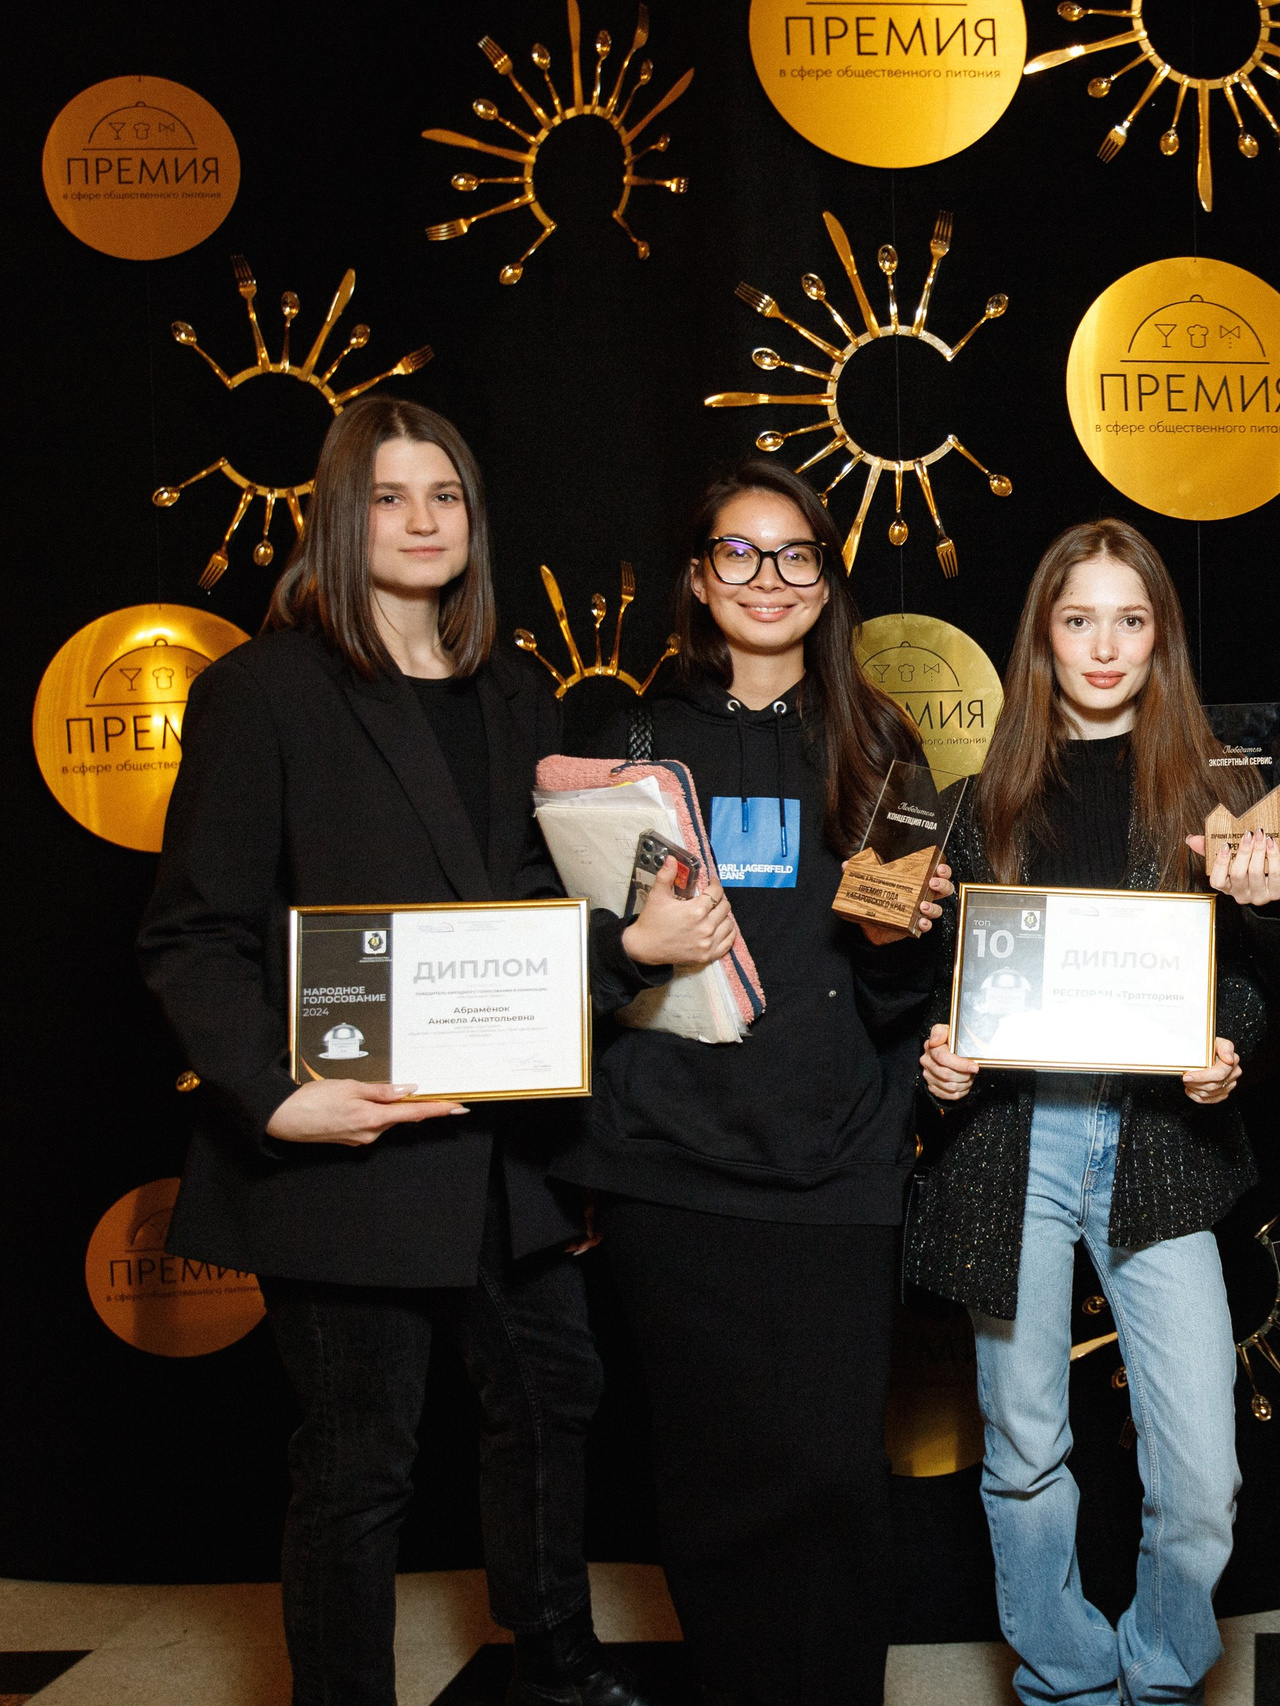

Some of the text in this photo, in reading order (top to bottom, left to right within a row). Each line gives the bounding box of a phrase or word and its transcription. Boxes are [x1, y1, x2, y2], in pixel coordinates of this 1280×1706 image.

[785, 17, 996, 56] ПРЕМИЯ
[780, 65, 1001, 81] в сфере общественного питания
[67, 157, 219, 185] ПРЕМИЯ
[71, 192, 101, 202] сфере
[104, 191, 180, 200] общественного
[1096, 424, 1102, 433] в
[1106, 421, 1145, 436] сфере
[1149, 421, 1247, 434] общественного
[946, 737, 987, 746] питания
[1222, 745, 1263, 755] Победитель
[1209, 756, 1273, 767] ЭКСПЕРТНЫЙ СЕРВИС
[62, 765, 69, 774] в
[73, 762, 112, 776] сфере
[898, 802, 936, 817] Победитель
[887, 812, 938, 831] КОНЦЕПЦИЯ ГОДА
[741, 864, 794, 874] LAGERFELD
[719, 872, 746, 880] EANS
[882, 890, 899, 901] ГОДА
[974, 919, 991, 928] ТОП
[973, 930, 1015, 959] 10
[1061, 949, 1181, 971] ДИПЛОМ
[413, 958, 549, 984] ДИПЛОМ
[304, 986, 366, 998] НАРОДНОЕ
[303, 994, 387, 1005] ГОЛОСОВАНИЕ
[303, 1007, 330, 1018] 2024
[428, 1014, 535, 1026] Анжела Анатольевна
